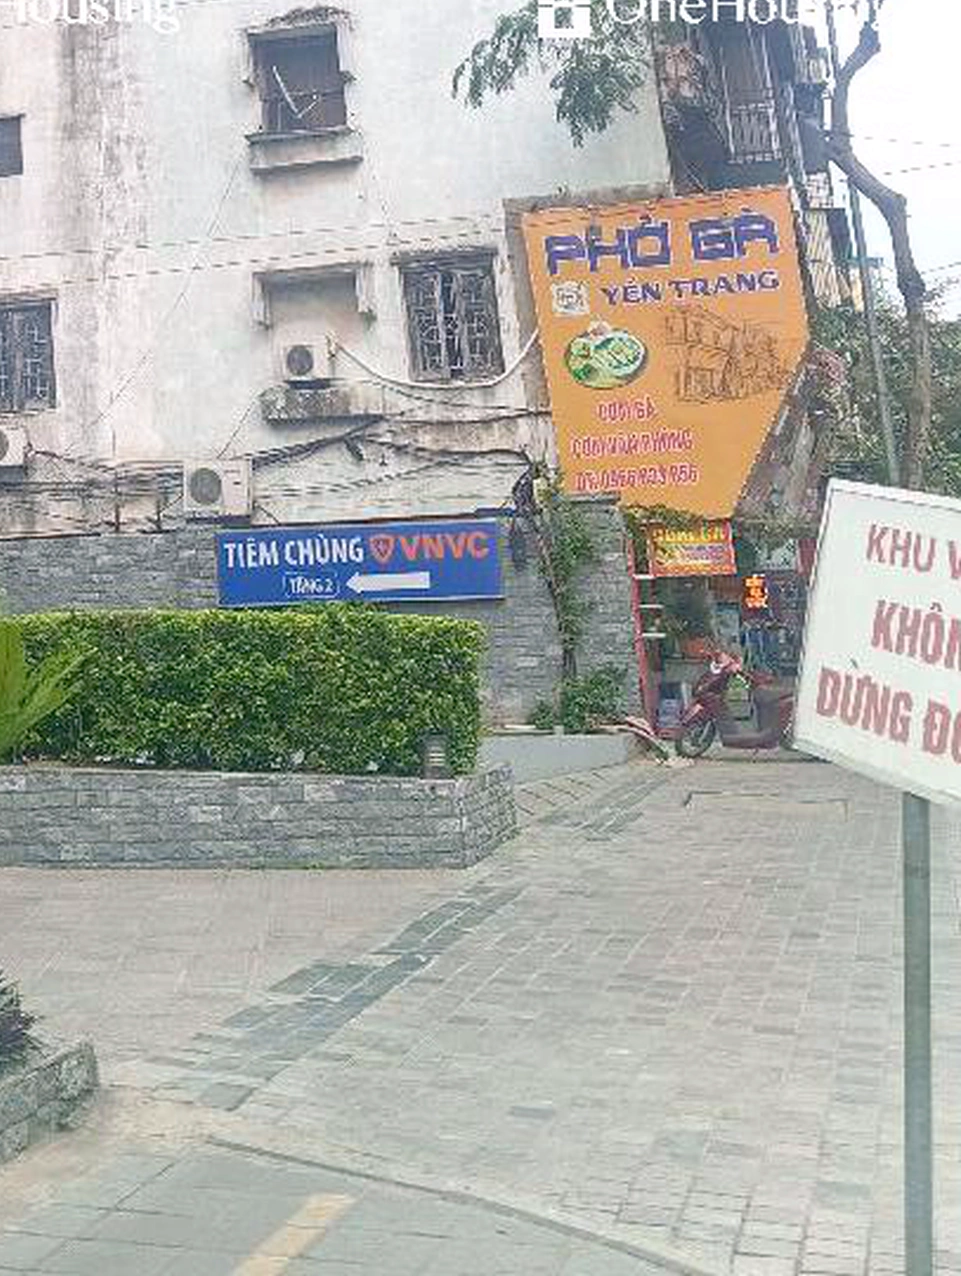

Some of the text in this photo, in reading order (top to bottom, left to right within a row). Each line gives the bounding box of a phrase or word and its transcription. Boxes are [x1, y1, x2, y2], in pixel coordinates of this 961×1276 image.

[667, 270, 780, 299] TRANG
[224, 534, 279, 568] TIÊM
[400, 530, 490, 562] VNVC
[866, 522, 937, 573] KHU
[324, 577, 334, 594] 2
